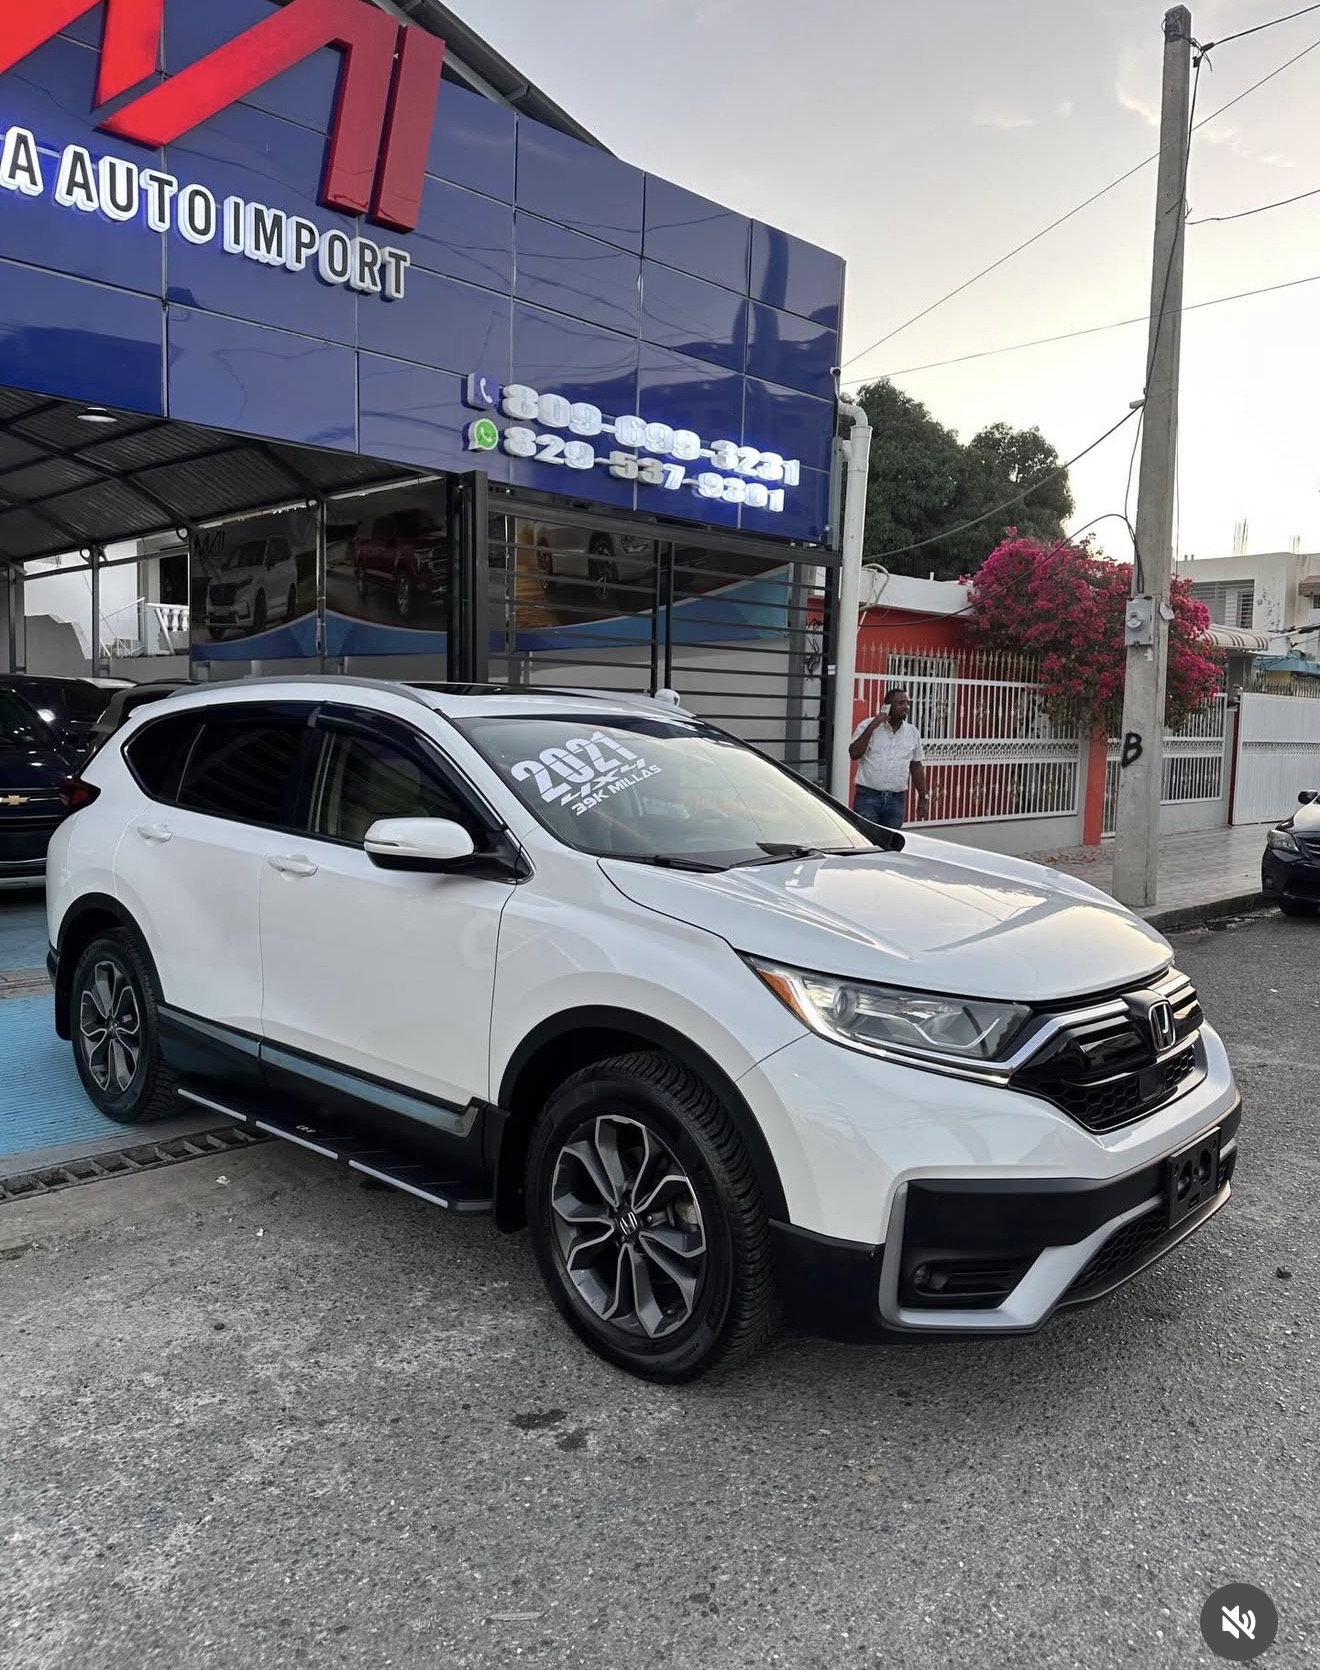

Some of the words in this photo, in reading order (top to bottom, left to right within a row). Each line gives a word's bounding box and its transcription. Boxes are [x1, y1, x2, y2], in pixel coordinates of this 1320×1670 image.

[502, 383, 801, 486] 809-699-3231
[504, 426, 785, 512] 829-537-9301
[511, 731, 639, 803] 2021
[1121, 732, 1143, 769] B
[571, 789, 610, 816] 39K
[607, 764, 662, 794] MILLAS
